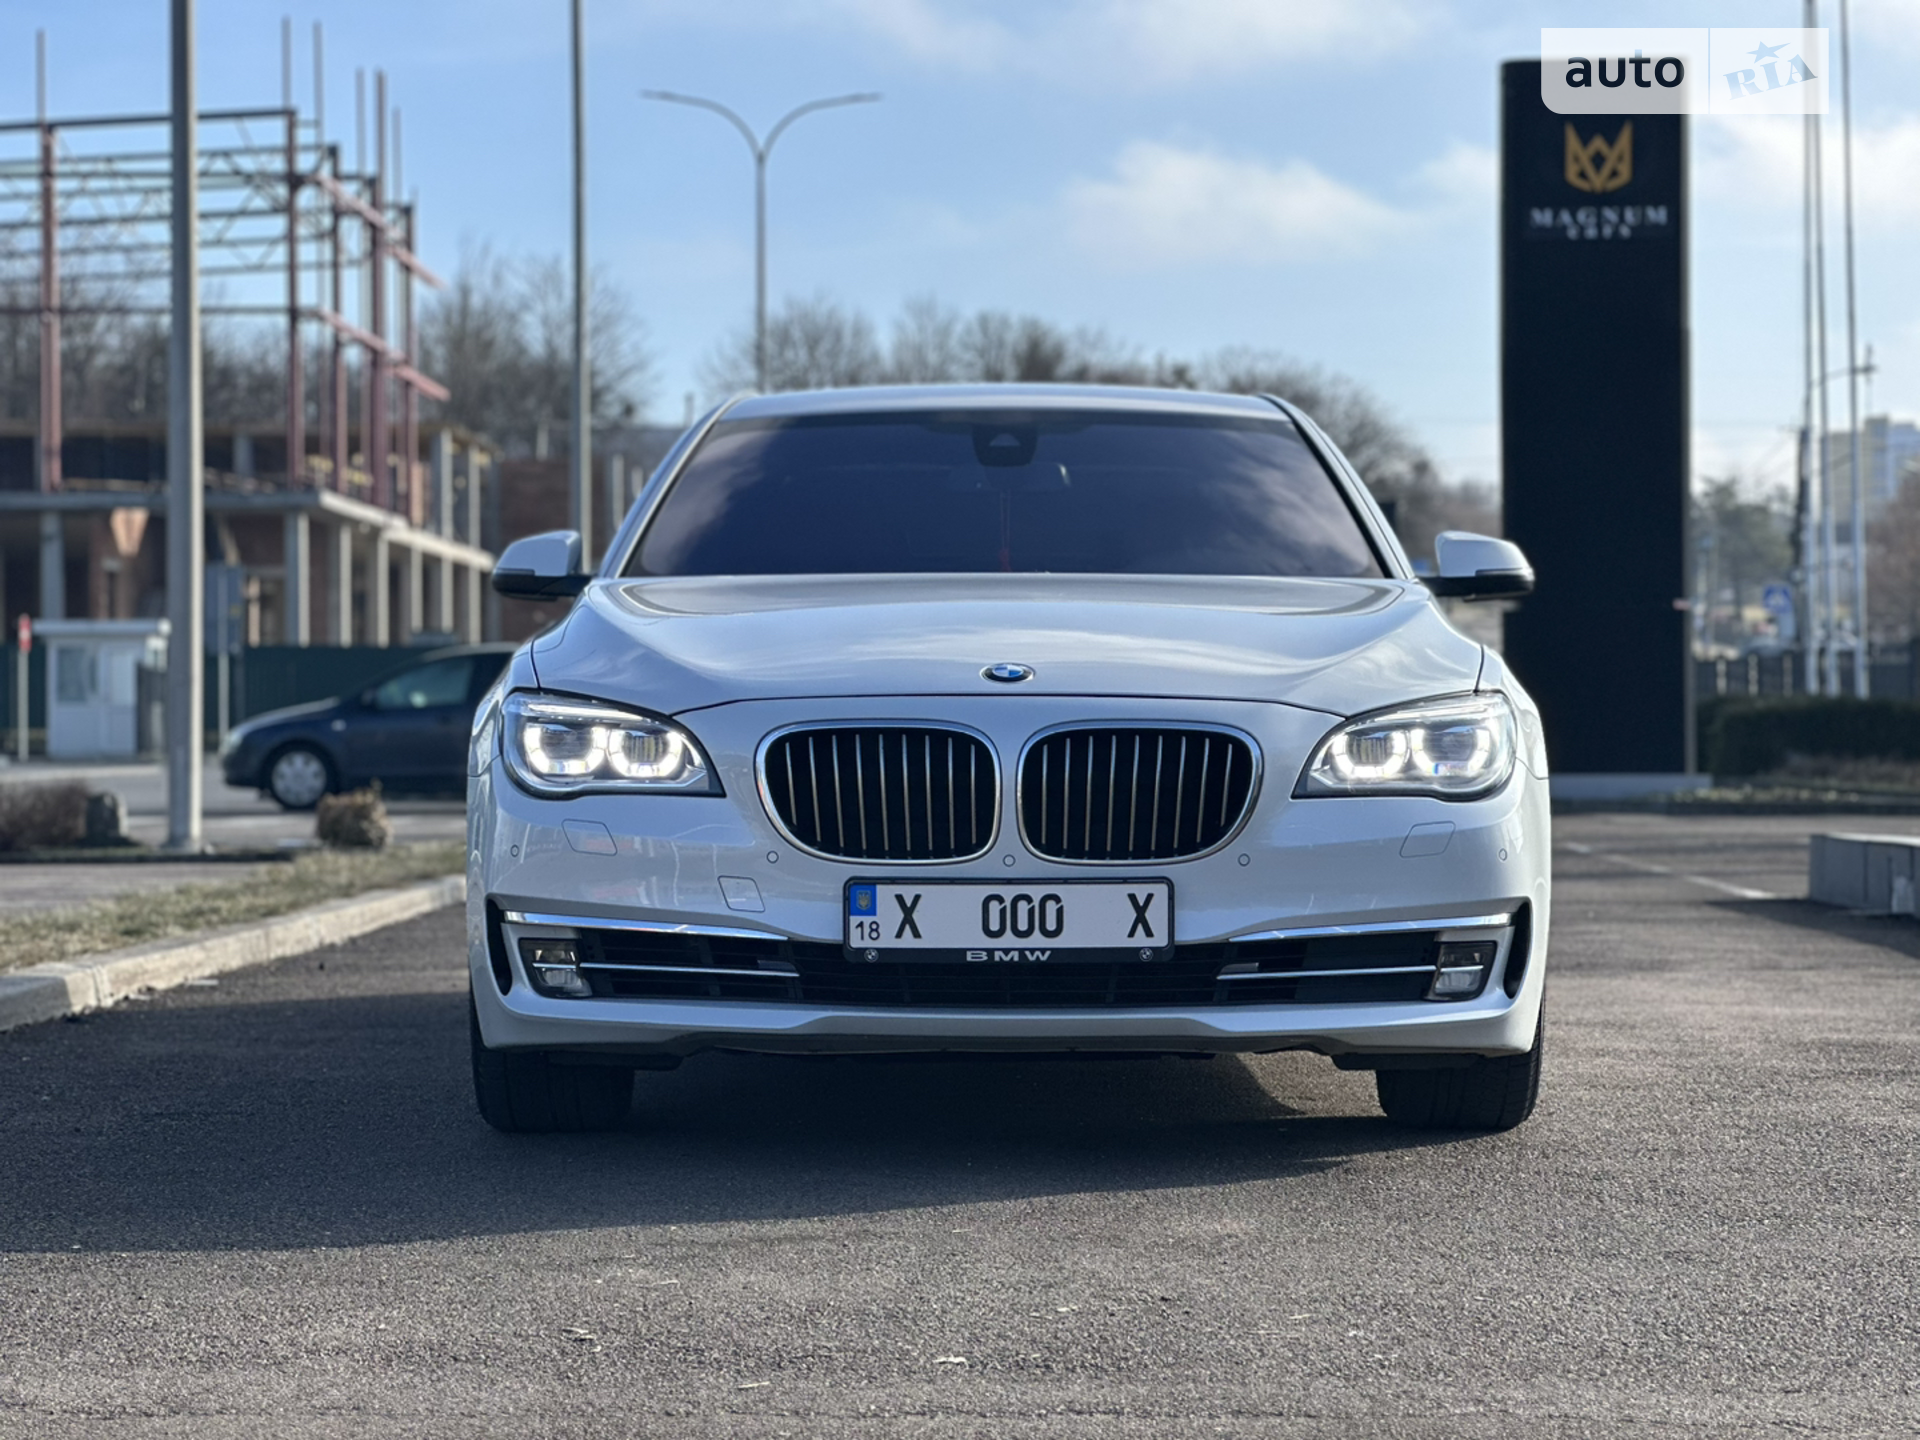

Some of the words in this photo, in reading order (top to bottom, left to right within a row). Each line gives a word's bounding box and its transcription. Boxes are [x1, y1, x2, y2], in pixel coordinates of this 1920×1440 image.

[1530, 206, 1667, 227] MAGNUM
[894, 894, 922, 939] X
[982, 893, 1065, 939] 000
[1127, 893, 1155, 939] X
[855, 921, 881, 941] 18
[966, 951, 1052, 962] BMW
